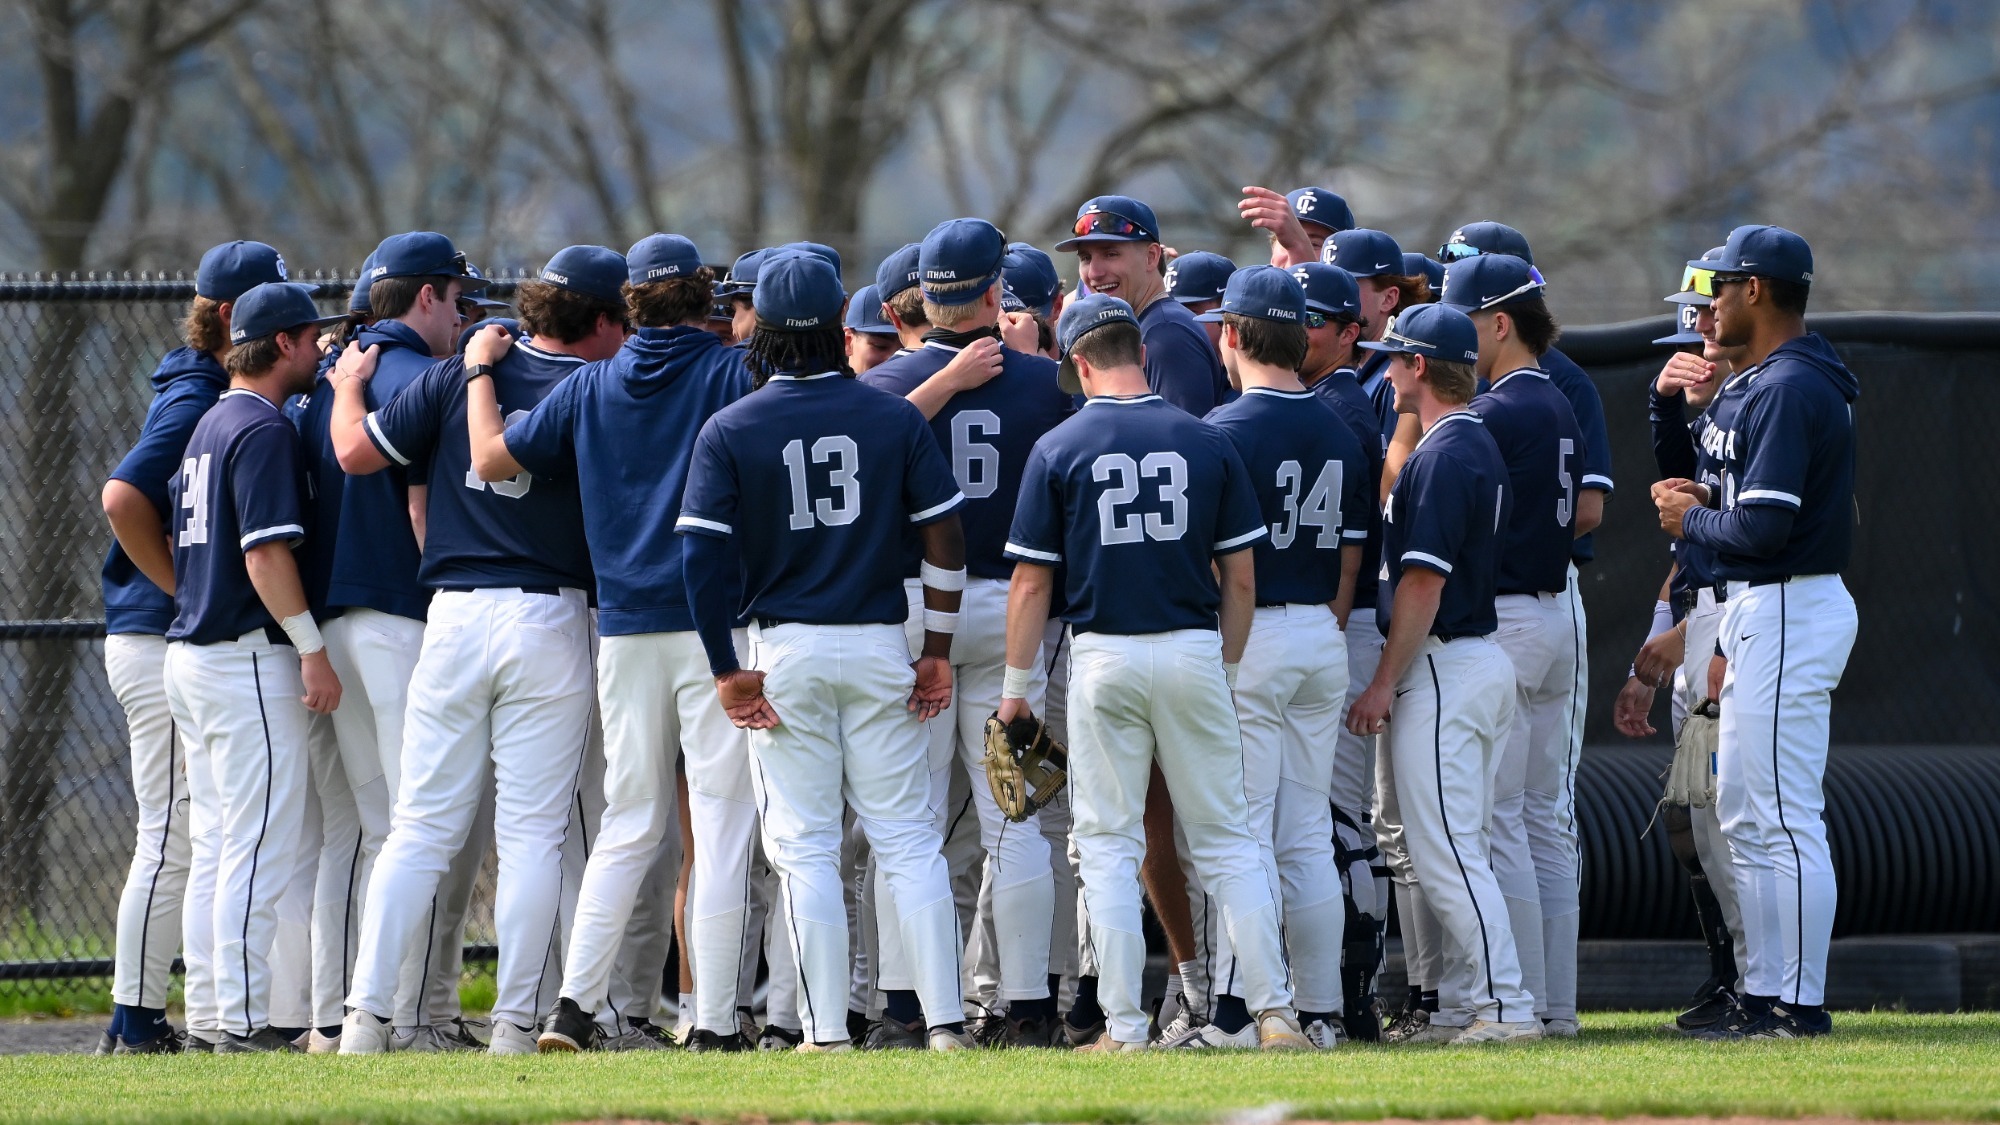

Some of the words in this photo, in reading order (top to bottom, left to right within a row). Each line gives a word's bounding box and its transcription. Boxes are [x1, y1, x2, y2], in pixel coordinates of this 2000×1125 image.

[544, 270, 569, 285] ITHACA
[648, 264, 680, 279] ITHACA
[927, 270, 957, 279] ITHACA
[1099, 309, 1129, 320] ITHACA
[1268, 308, 1297, 320] ITHACA
[786, 316, 819, 328] ITHACA
[951, 410, 1000, 498] 6
[782, 435, 861, 530] 13
[1557, 438, 1574, 527] 5
[1092, 452, 1188, 545] 23
[1271, 460, 1343, 549] 34
